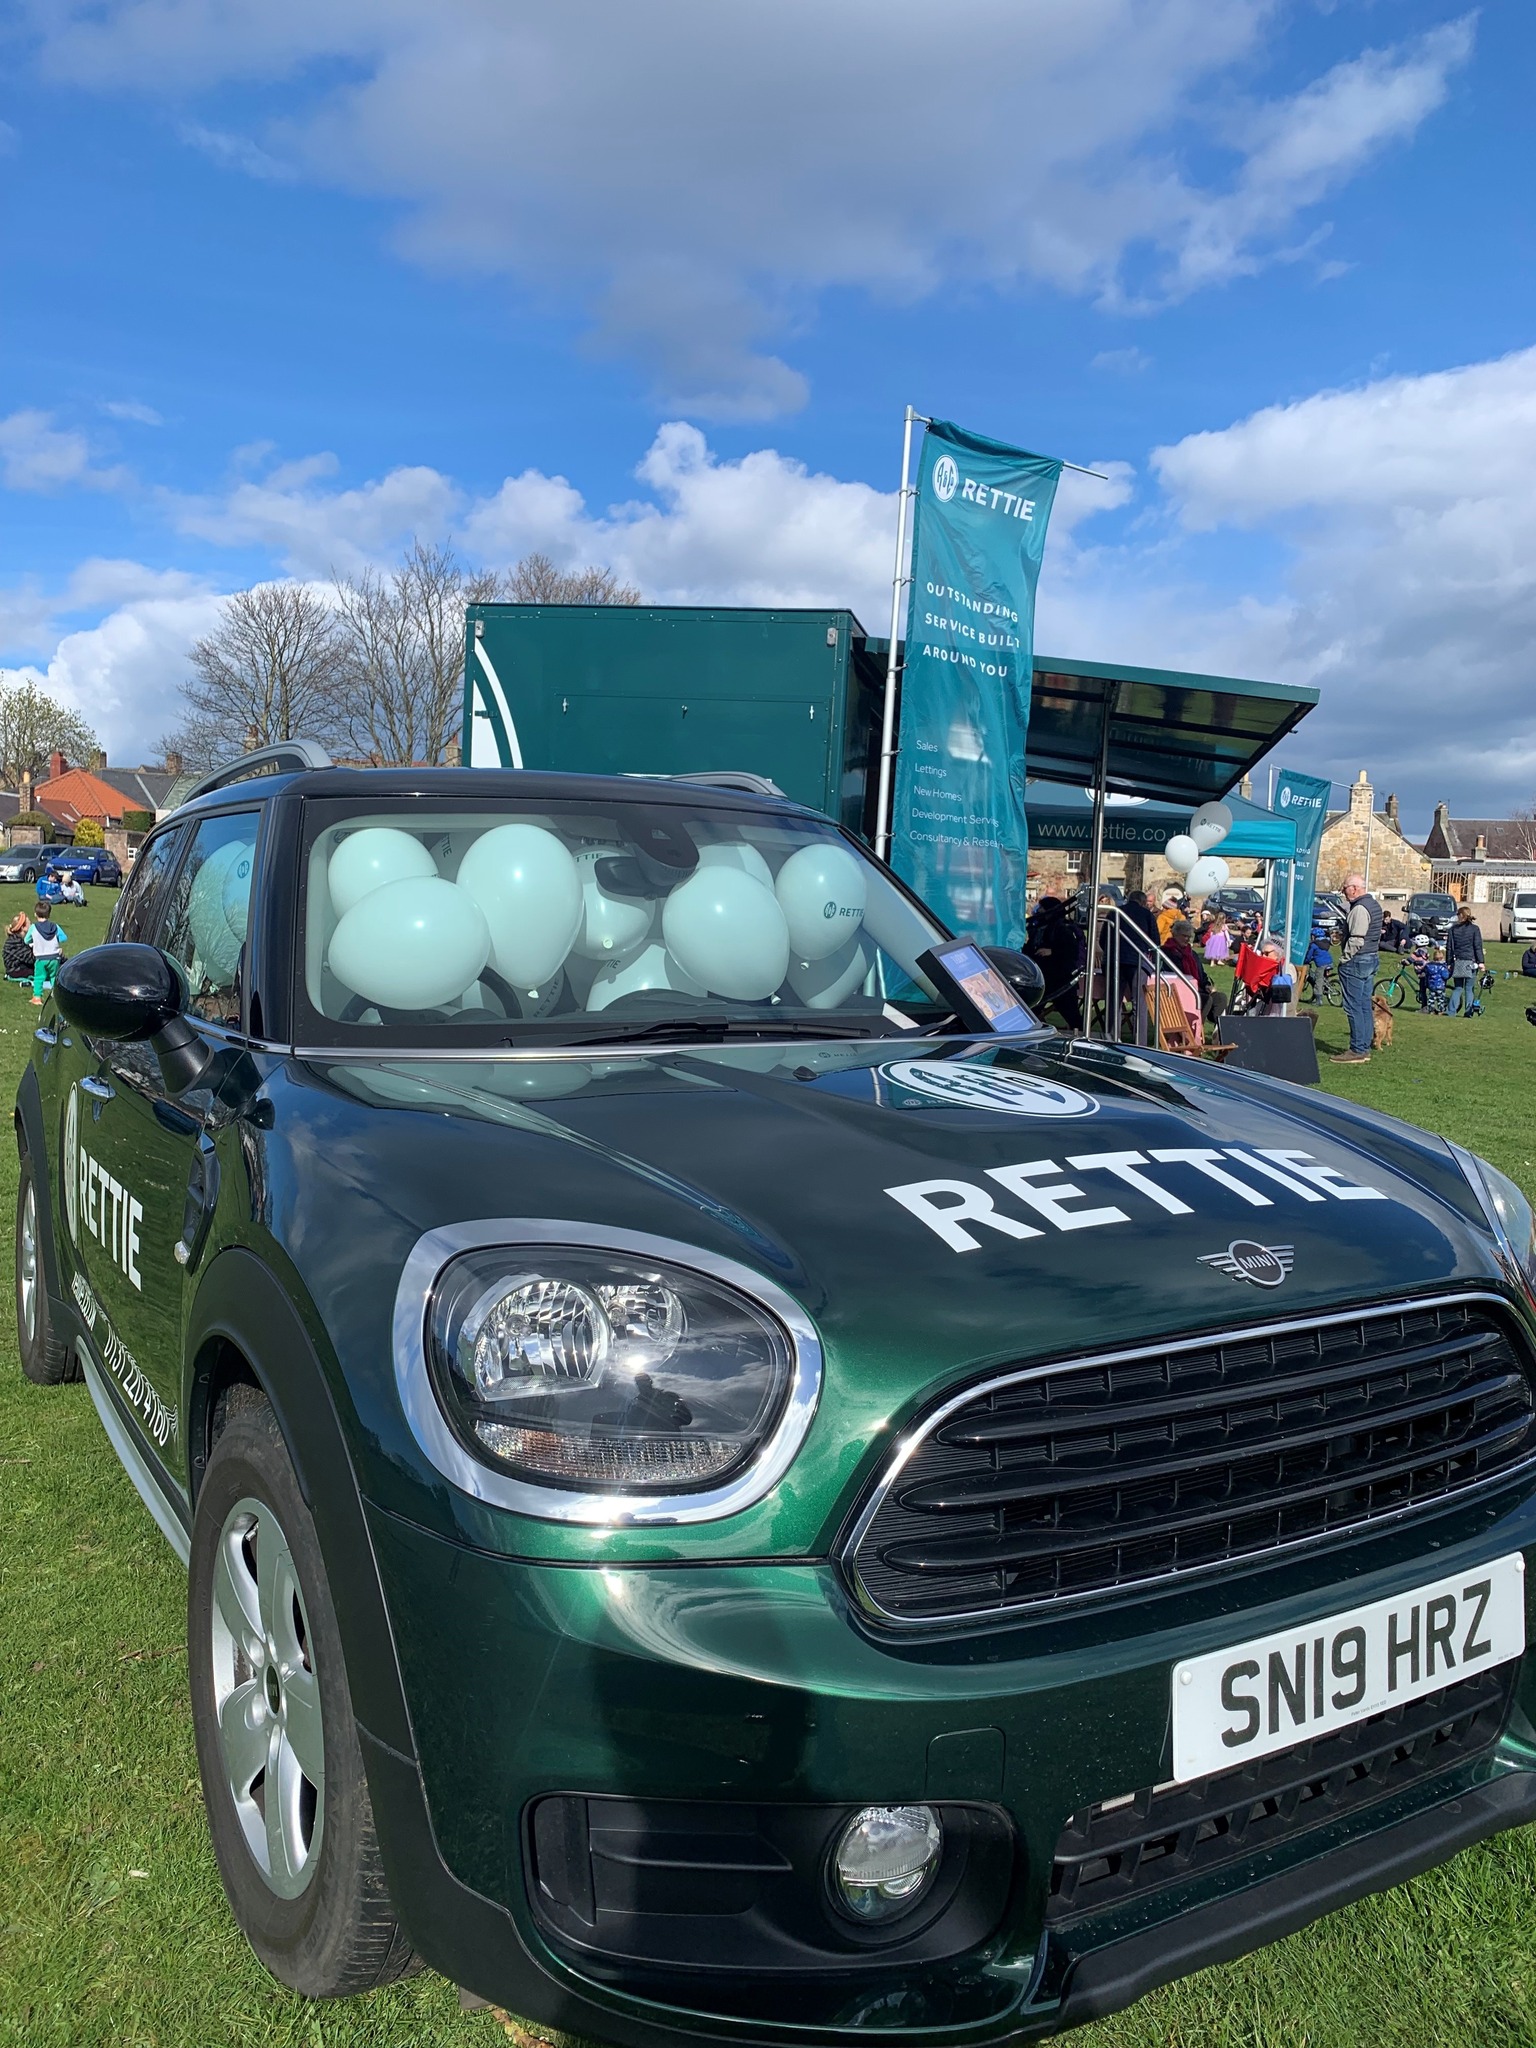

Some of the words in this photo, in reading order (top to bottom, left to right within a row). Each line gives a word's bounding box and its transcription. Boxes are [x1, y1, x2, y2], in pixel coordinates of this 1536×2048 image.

[962, 478, 1036, 521] RETTIE
[926, 582, 1018, 623] OUTSTANDING
[925, 613, 976, 639] SERVICE
[978, 632, 1020, 648] BUILT
[923, 645, 977, 668] AROUND
[979, 662, 1008, 677] YOU
[916, 740, 938, 753] Sales
[915, 763, 947, 779] Lettings
[914, 785, 932, 797] New
[932, 789, 962, 801] Homes
[1291, 795, 1322, 808] RETTIE
[912, 808, 967, 824] Development
[909, 830, 961, 847] Consultancy
[962, 837, 970, 846] &
[883, 1148, 1389, 1253] RETTIE
[80, 1145, 144, 1292] RETTIE
[1238, 1254, 1276, 1269] MINI
[1221, 1626, 1367, 1748] SN19
[1387, 1578, 1492, 1693] HRZ
